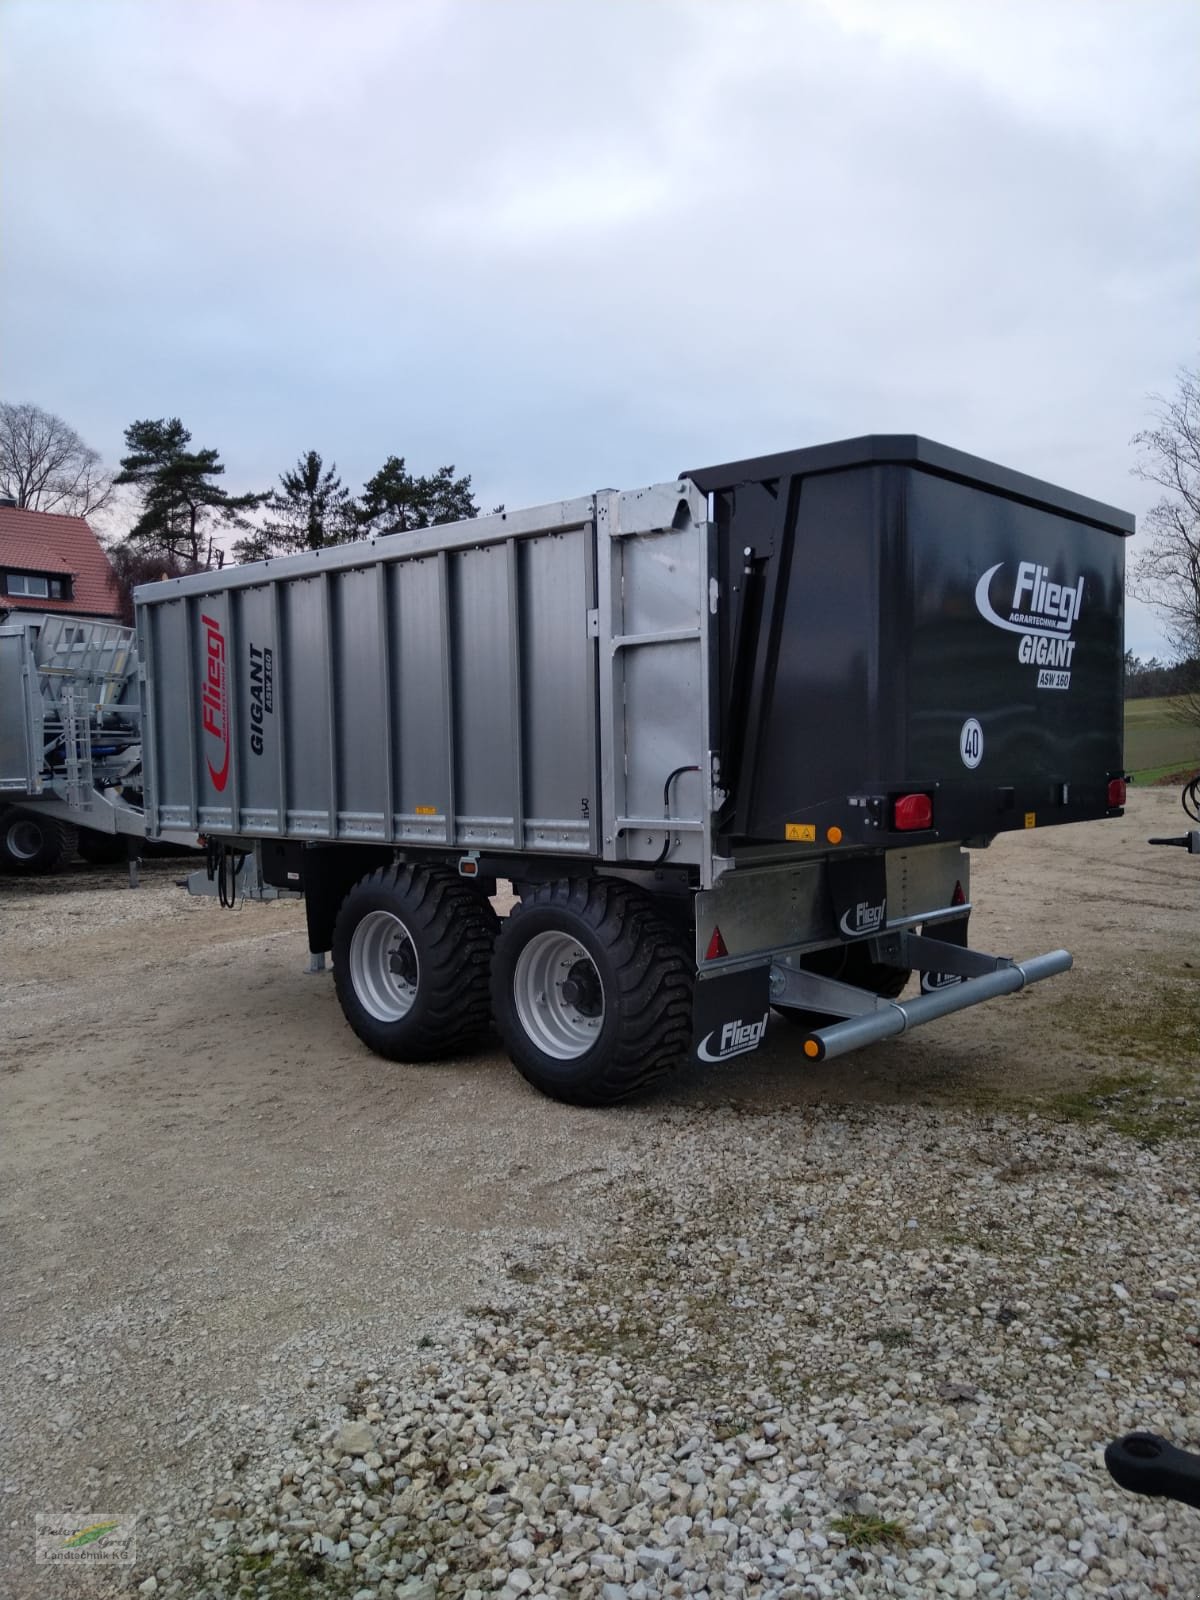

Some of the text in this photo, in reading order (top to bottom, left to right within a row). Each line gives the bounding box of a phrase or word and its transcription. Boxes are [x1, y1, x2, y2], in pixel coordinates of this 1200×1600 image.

[1012, 561, 1085, 631] Fliegl
[1008, 612, 1058, 629] AGRARTECHNIK
[1018, 635, 1076, 668] GIGANT
[201, 613, 226, 739] Fliegl
[265, 654, 273, 709] ASW 160
[1039, 672, 1069, 688] ASW 160
[250, 642, 264, 756] GIGANT
[964, 728, 979, 759] 40
[856, 898, 887, 927] Fliegl
[720, 1012, 769, 1051] Fliegl
